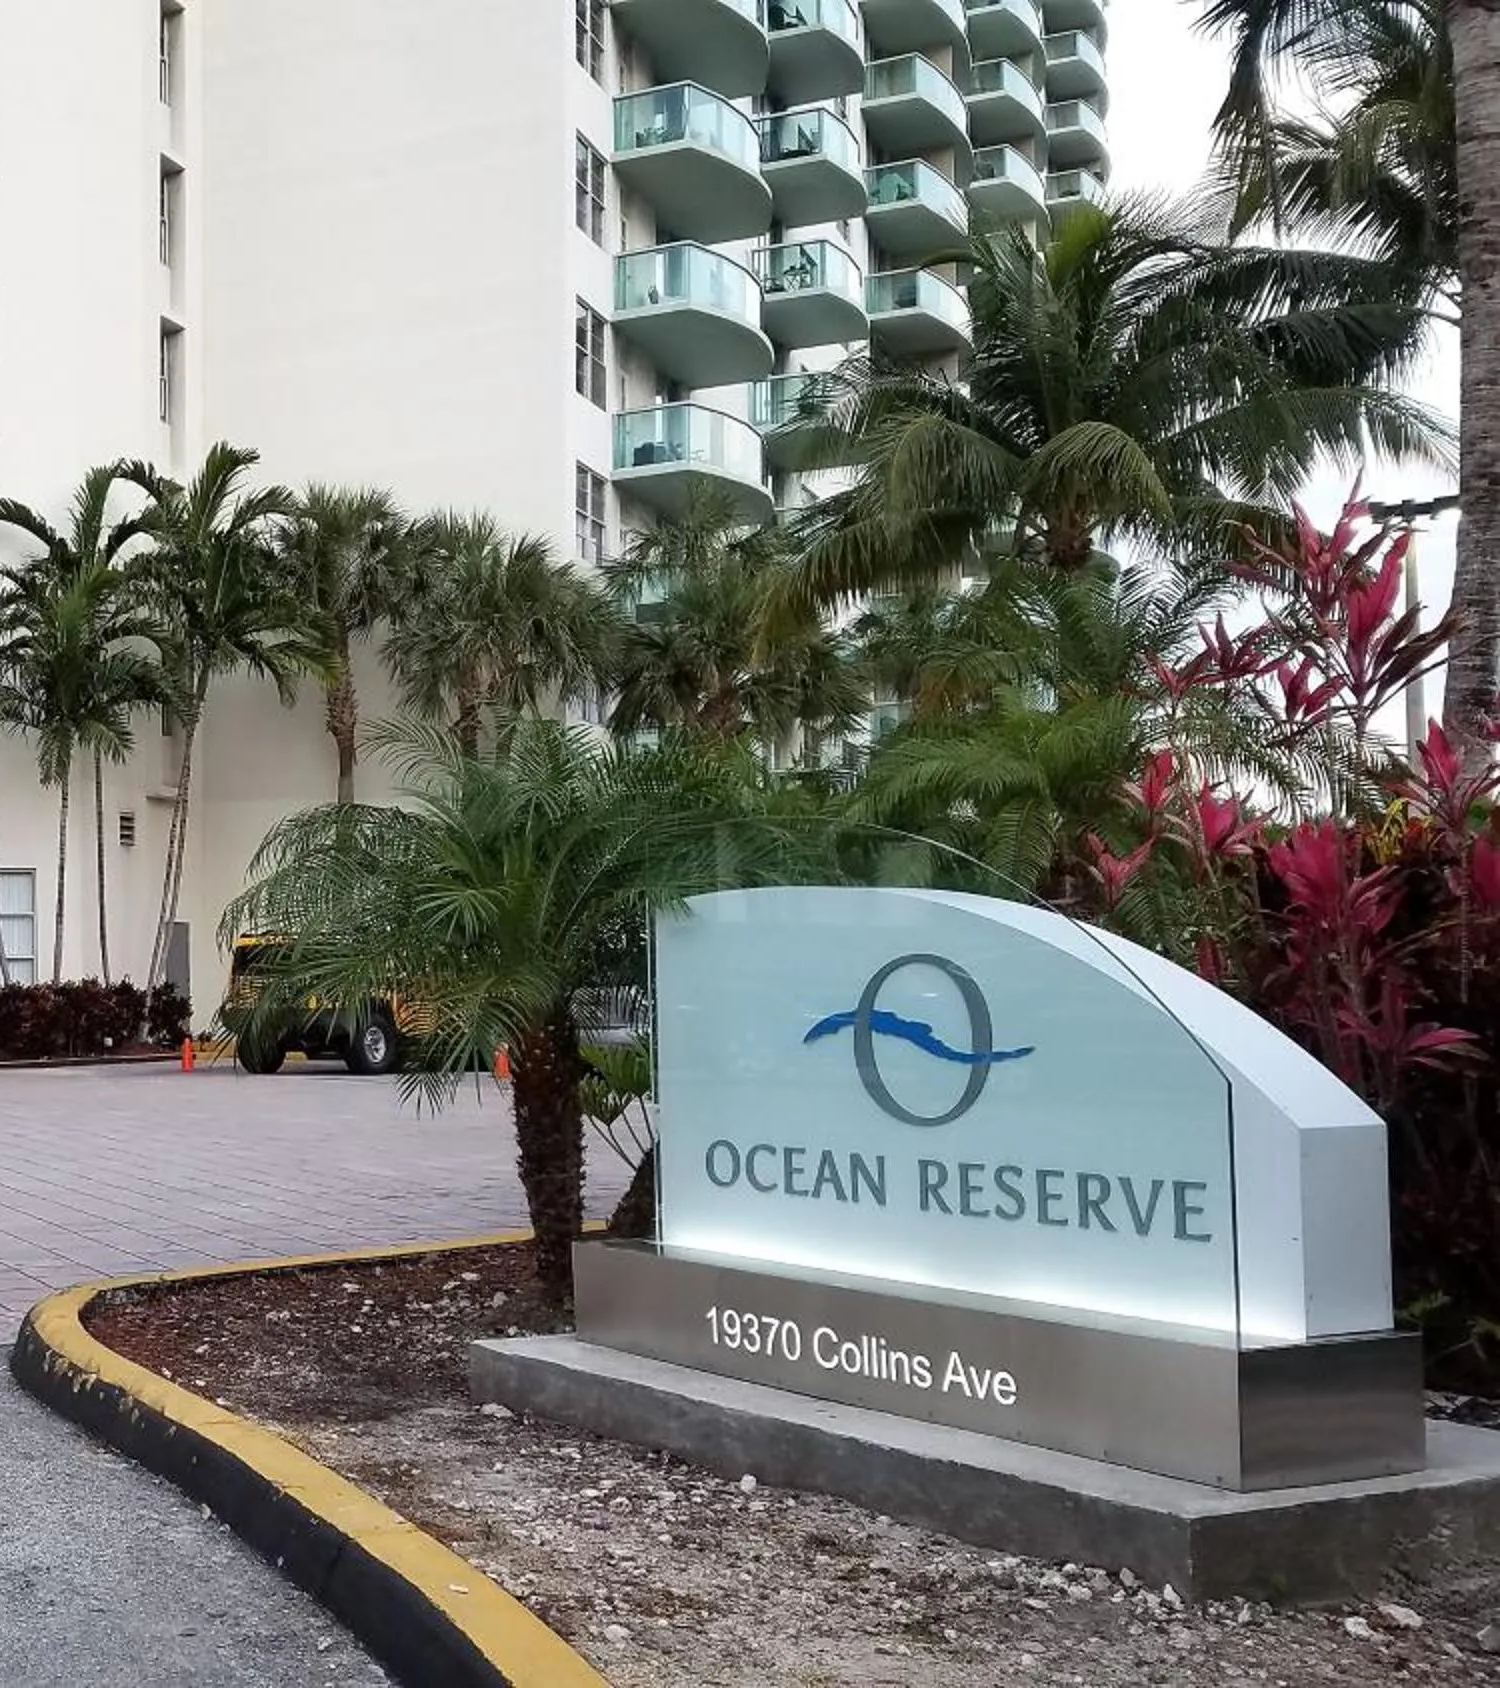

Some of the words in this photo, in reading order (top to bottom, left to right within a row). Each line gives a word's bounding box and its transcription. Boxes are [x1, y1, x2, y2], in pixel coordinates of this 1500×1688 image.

[705, 1139, 887, 1206] OCEAN
[917, 1159, 1212, 1242] RESERVE
[705, 1305, 801, 1361] 19370
[812, 1326, 933, 1389] Collins
[941, 1350, 1017, 1405] Ave
